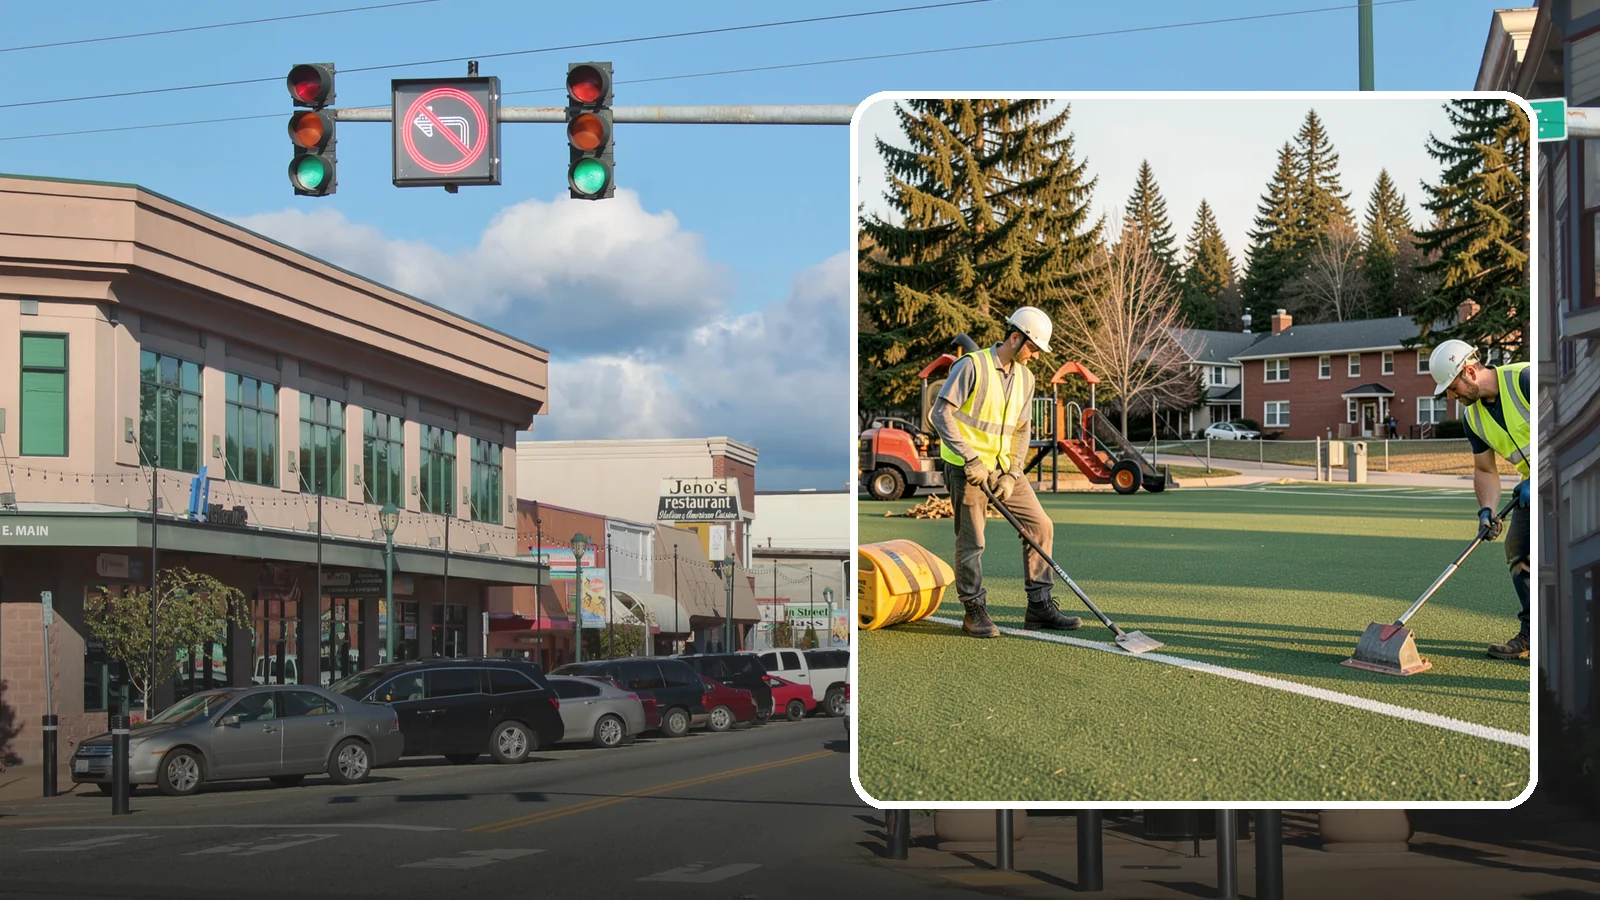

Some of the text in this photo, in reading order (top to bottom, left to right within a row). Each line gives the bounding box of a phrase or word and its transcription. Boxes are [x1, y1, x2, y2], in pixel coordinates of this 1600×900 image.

[669, 480, 728, 495] Jeno's
[665, 496, 731, 509] restaurant
[658, 509, 681, 519] Italian
[686, 509, 715, 519] American
[715, 509, 738, 519] Cuisine
[2, 525, 49, 536] E. MAIN
[797, 607, 828, 617] Street
[790, 619, 824, 628] lass
